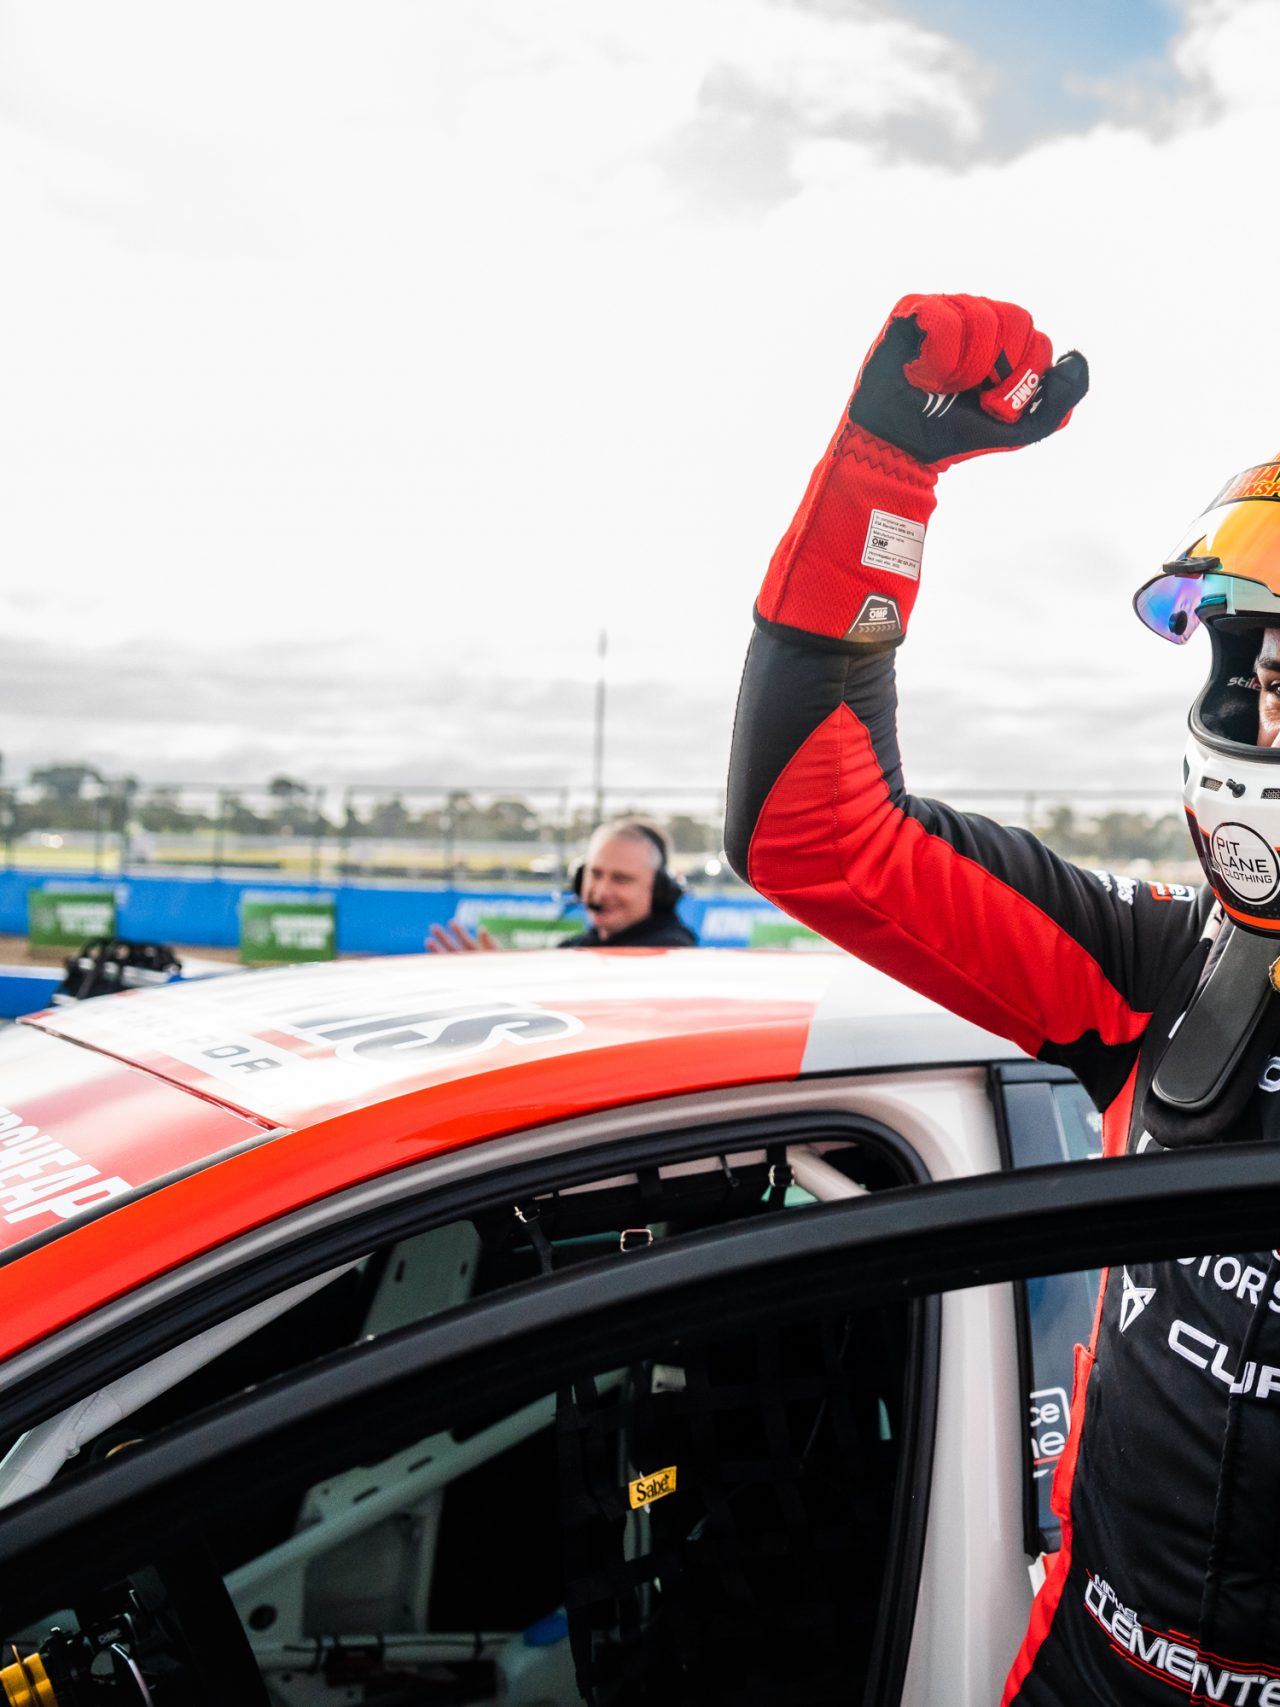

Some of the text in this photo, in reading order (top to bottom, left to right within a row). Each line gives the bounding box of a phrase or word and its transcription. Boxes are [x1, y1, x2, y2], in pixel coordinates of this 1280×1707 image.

[1011, 372, 1040, 410] OMP
[871, 537, 889, 548] OMP
[869, 609, 888, 619] OMP
[1216, 836, 1240, 857] PIT
[1219, 852, 1269, 874] LANE
[1224, 867, 1273, 885] CLOTHING
